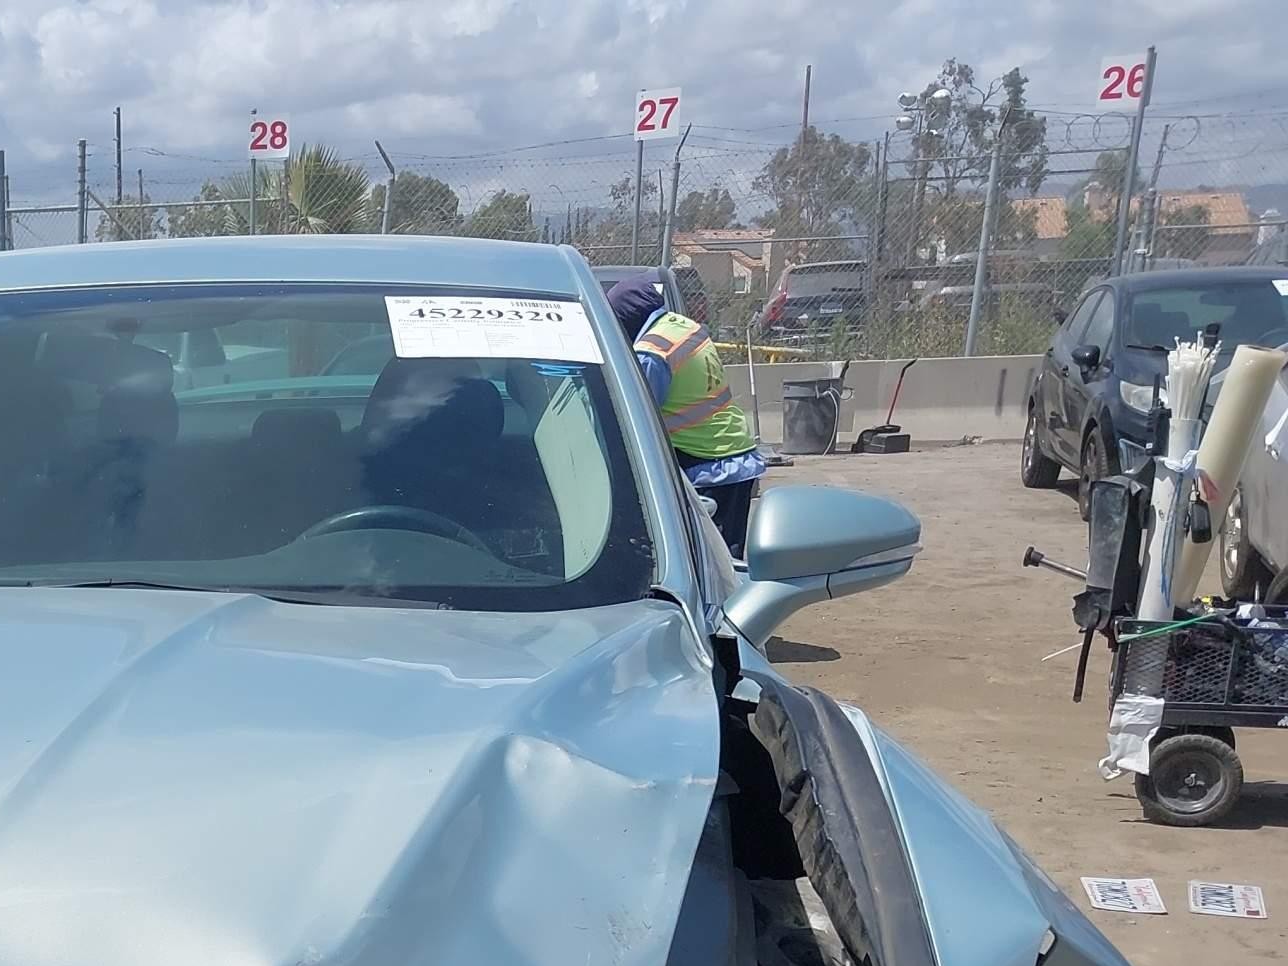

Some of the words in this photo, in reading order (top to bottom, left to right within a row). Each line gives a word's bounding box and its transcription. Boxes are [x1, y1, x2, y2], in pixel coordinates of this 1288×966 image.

[1099, 63, 1146, 100] 26
[636, 97, 679, 132] 27
[249, 120, 288, 151] 28
[409, 307, 563, 322] 45229320
